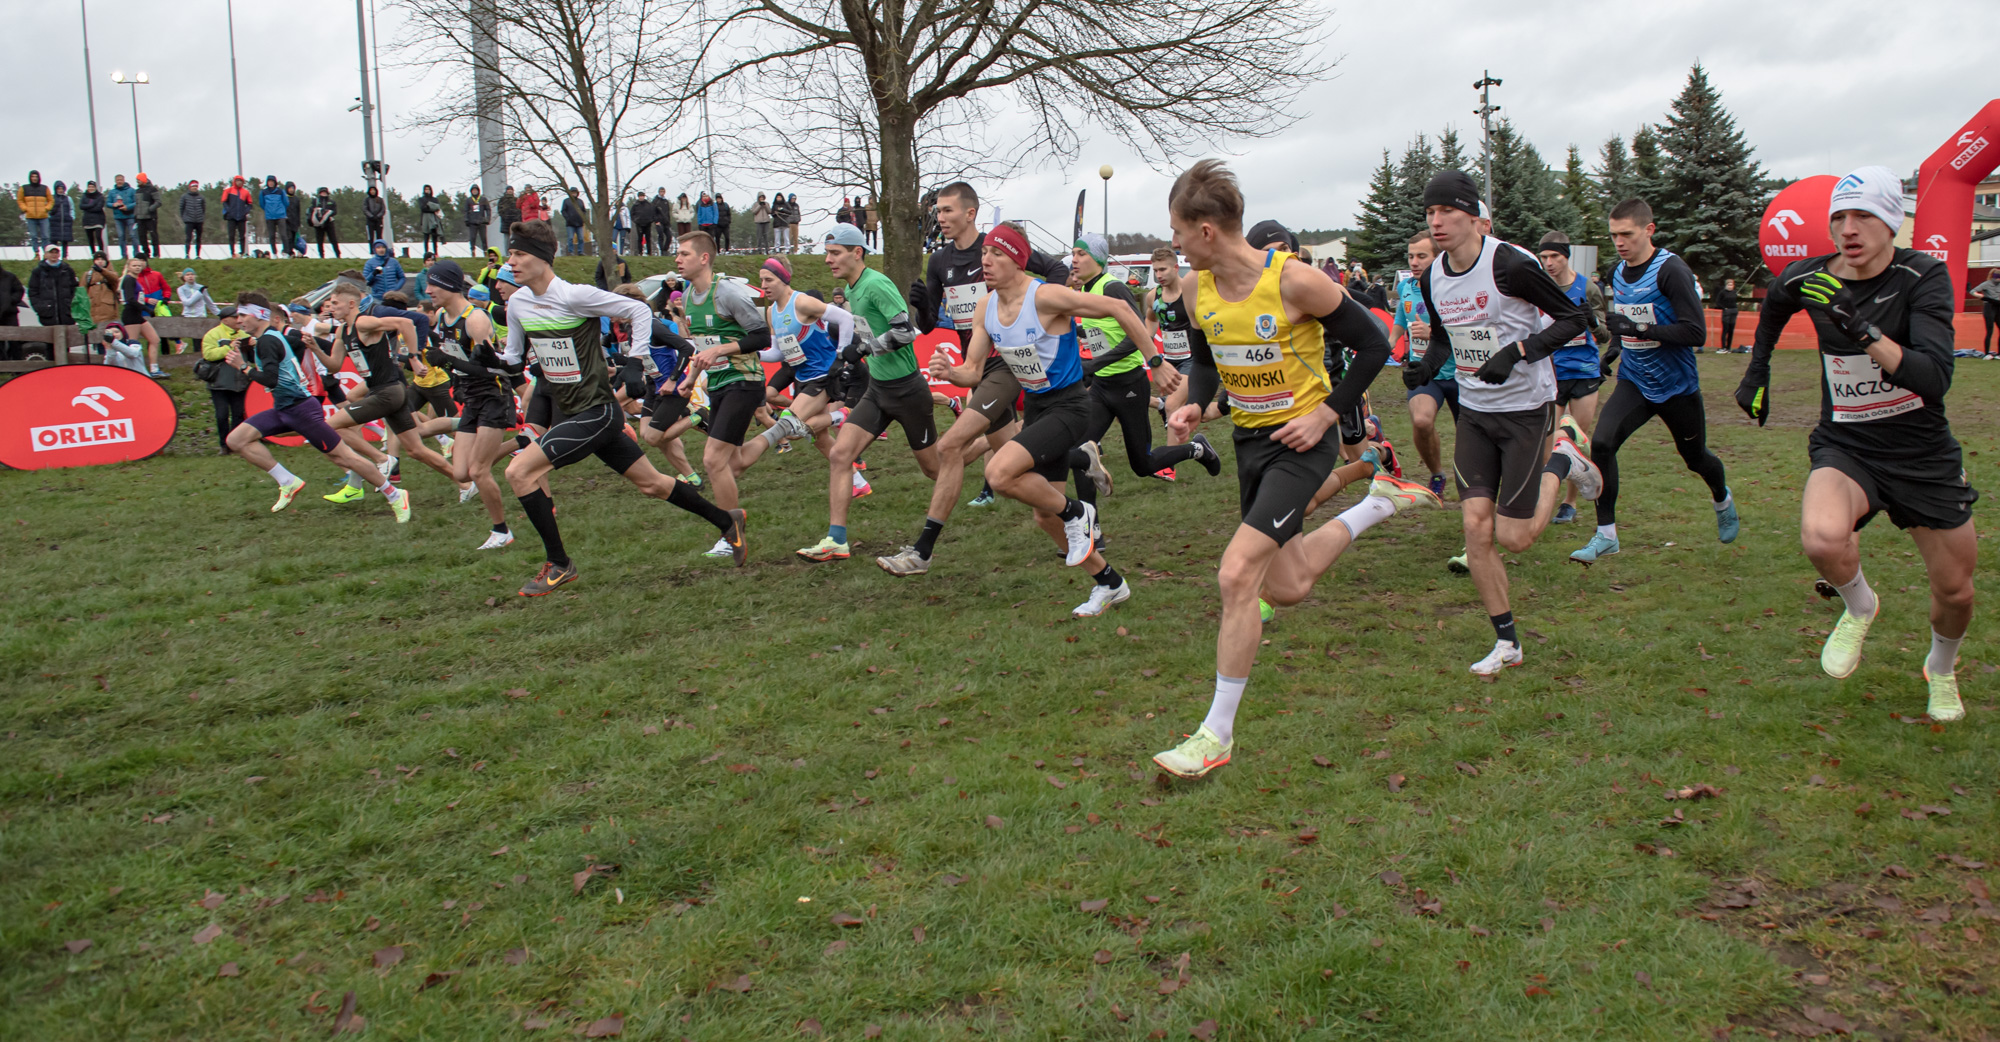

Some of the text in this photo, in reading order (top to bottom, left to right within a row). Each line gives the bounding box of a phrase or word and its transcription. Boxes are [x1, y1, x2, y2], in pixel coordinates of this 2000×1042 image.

[1954, 140, 1985, 167] ORLEN
[1765, 244, 1808, 257] ORLEN
[970, 285, 977, 295] 9
[1631, 306, 1649, 316] 204
[1088, 328, 1101, 338] 212
[1470, 330, 1491, 341] 384
[551, 340, 569, 350] 431
[704, 337, 715, 346] 61
[1014, 347, 1033, 358] 498
[1245, 347, 1274, 362] 466
[1454, 347, 1491, 364] PIĄTEK
[1220, 368, 1286, 389] BOROWSKI
[1833, 380, 1901, 398] KACZO
[1250, 402, 1270, 410] GÓRA
[1271, 399, 1289, 408] 2023
[1839, 401, 1916, 420] ZIELONA GÓRA 2023
[38, 422, 128, 447] ORLEN
